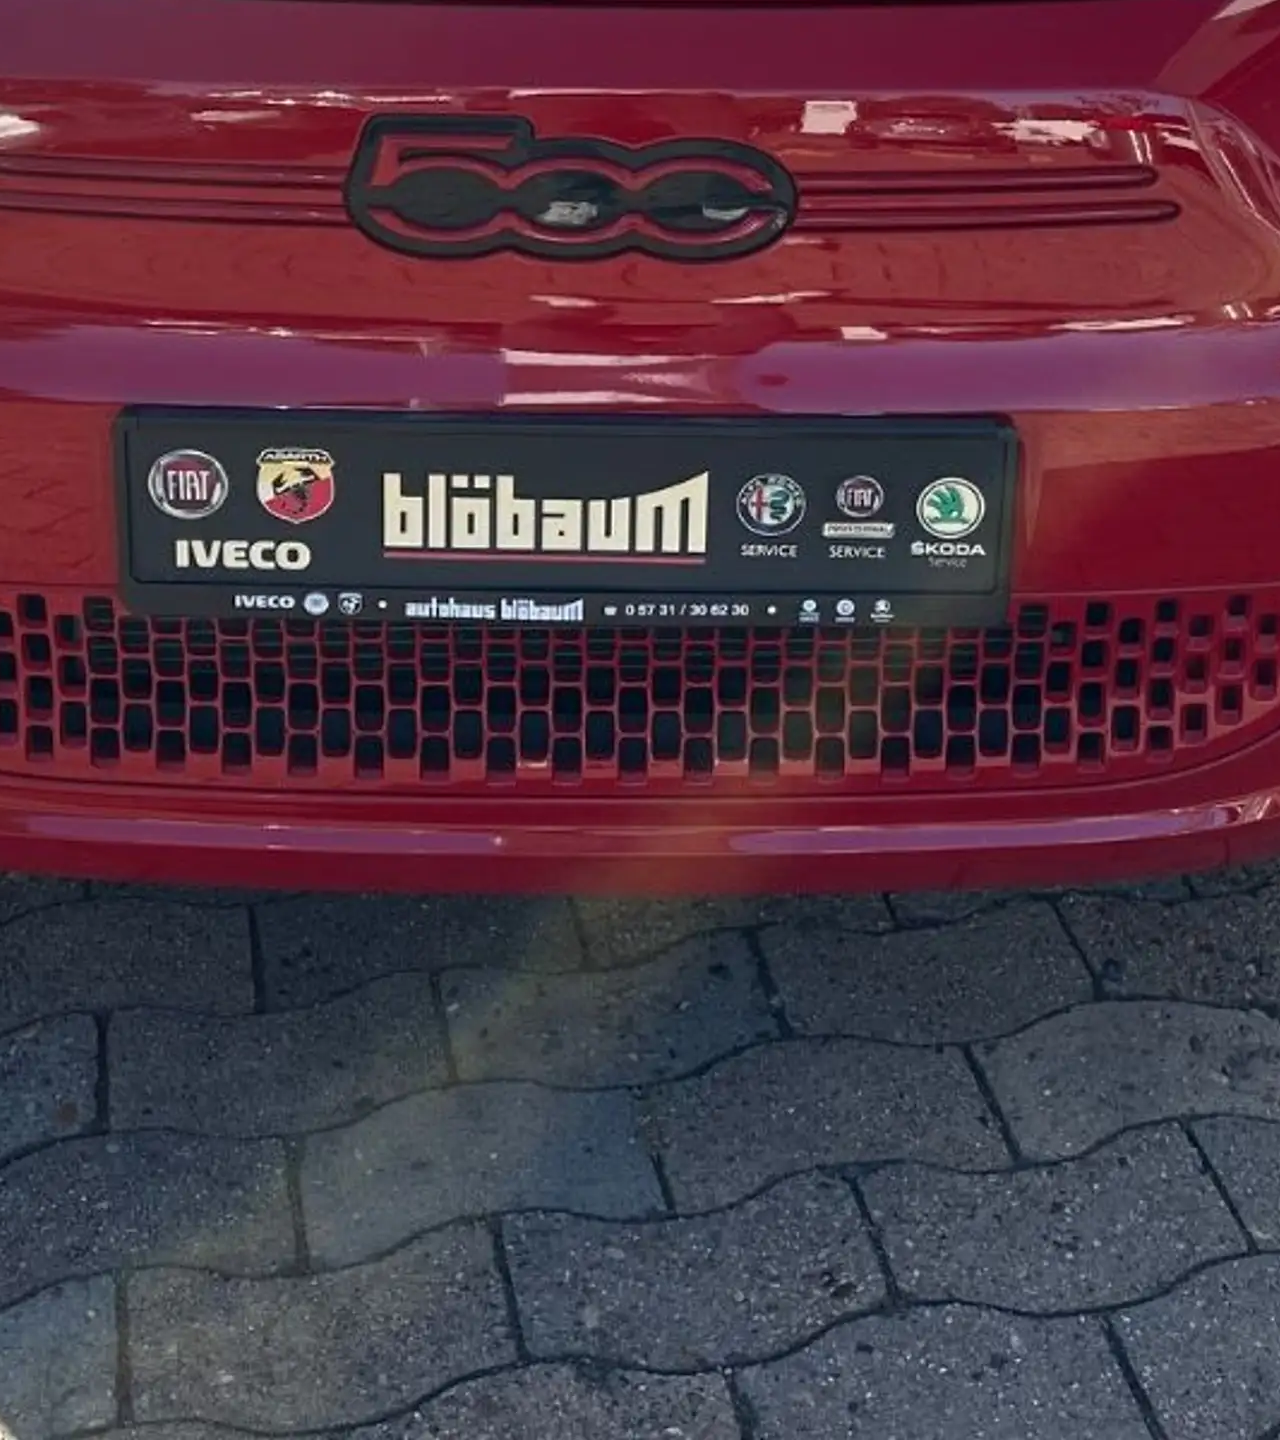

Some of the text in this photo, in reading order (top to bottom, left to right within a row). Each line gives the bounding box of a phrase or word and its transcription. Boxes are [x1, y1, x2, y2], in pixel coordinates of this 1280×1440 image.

[346, 114, 797, 261] 500
[166, 470, 210, 501] FIAT
[383, 471, 709, 553] blöbaum
[175, 539, 312, 571] IVECO
[740, 544, 799, 558] SERVICE
[828, 544, 885, 558] SERVICE
[234, 595, 296, 609] IVECO
[405, 597, 496, 619] autohaus
